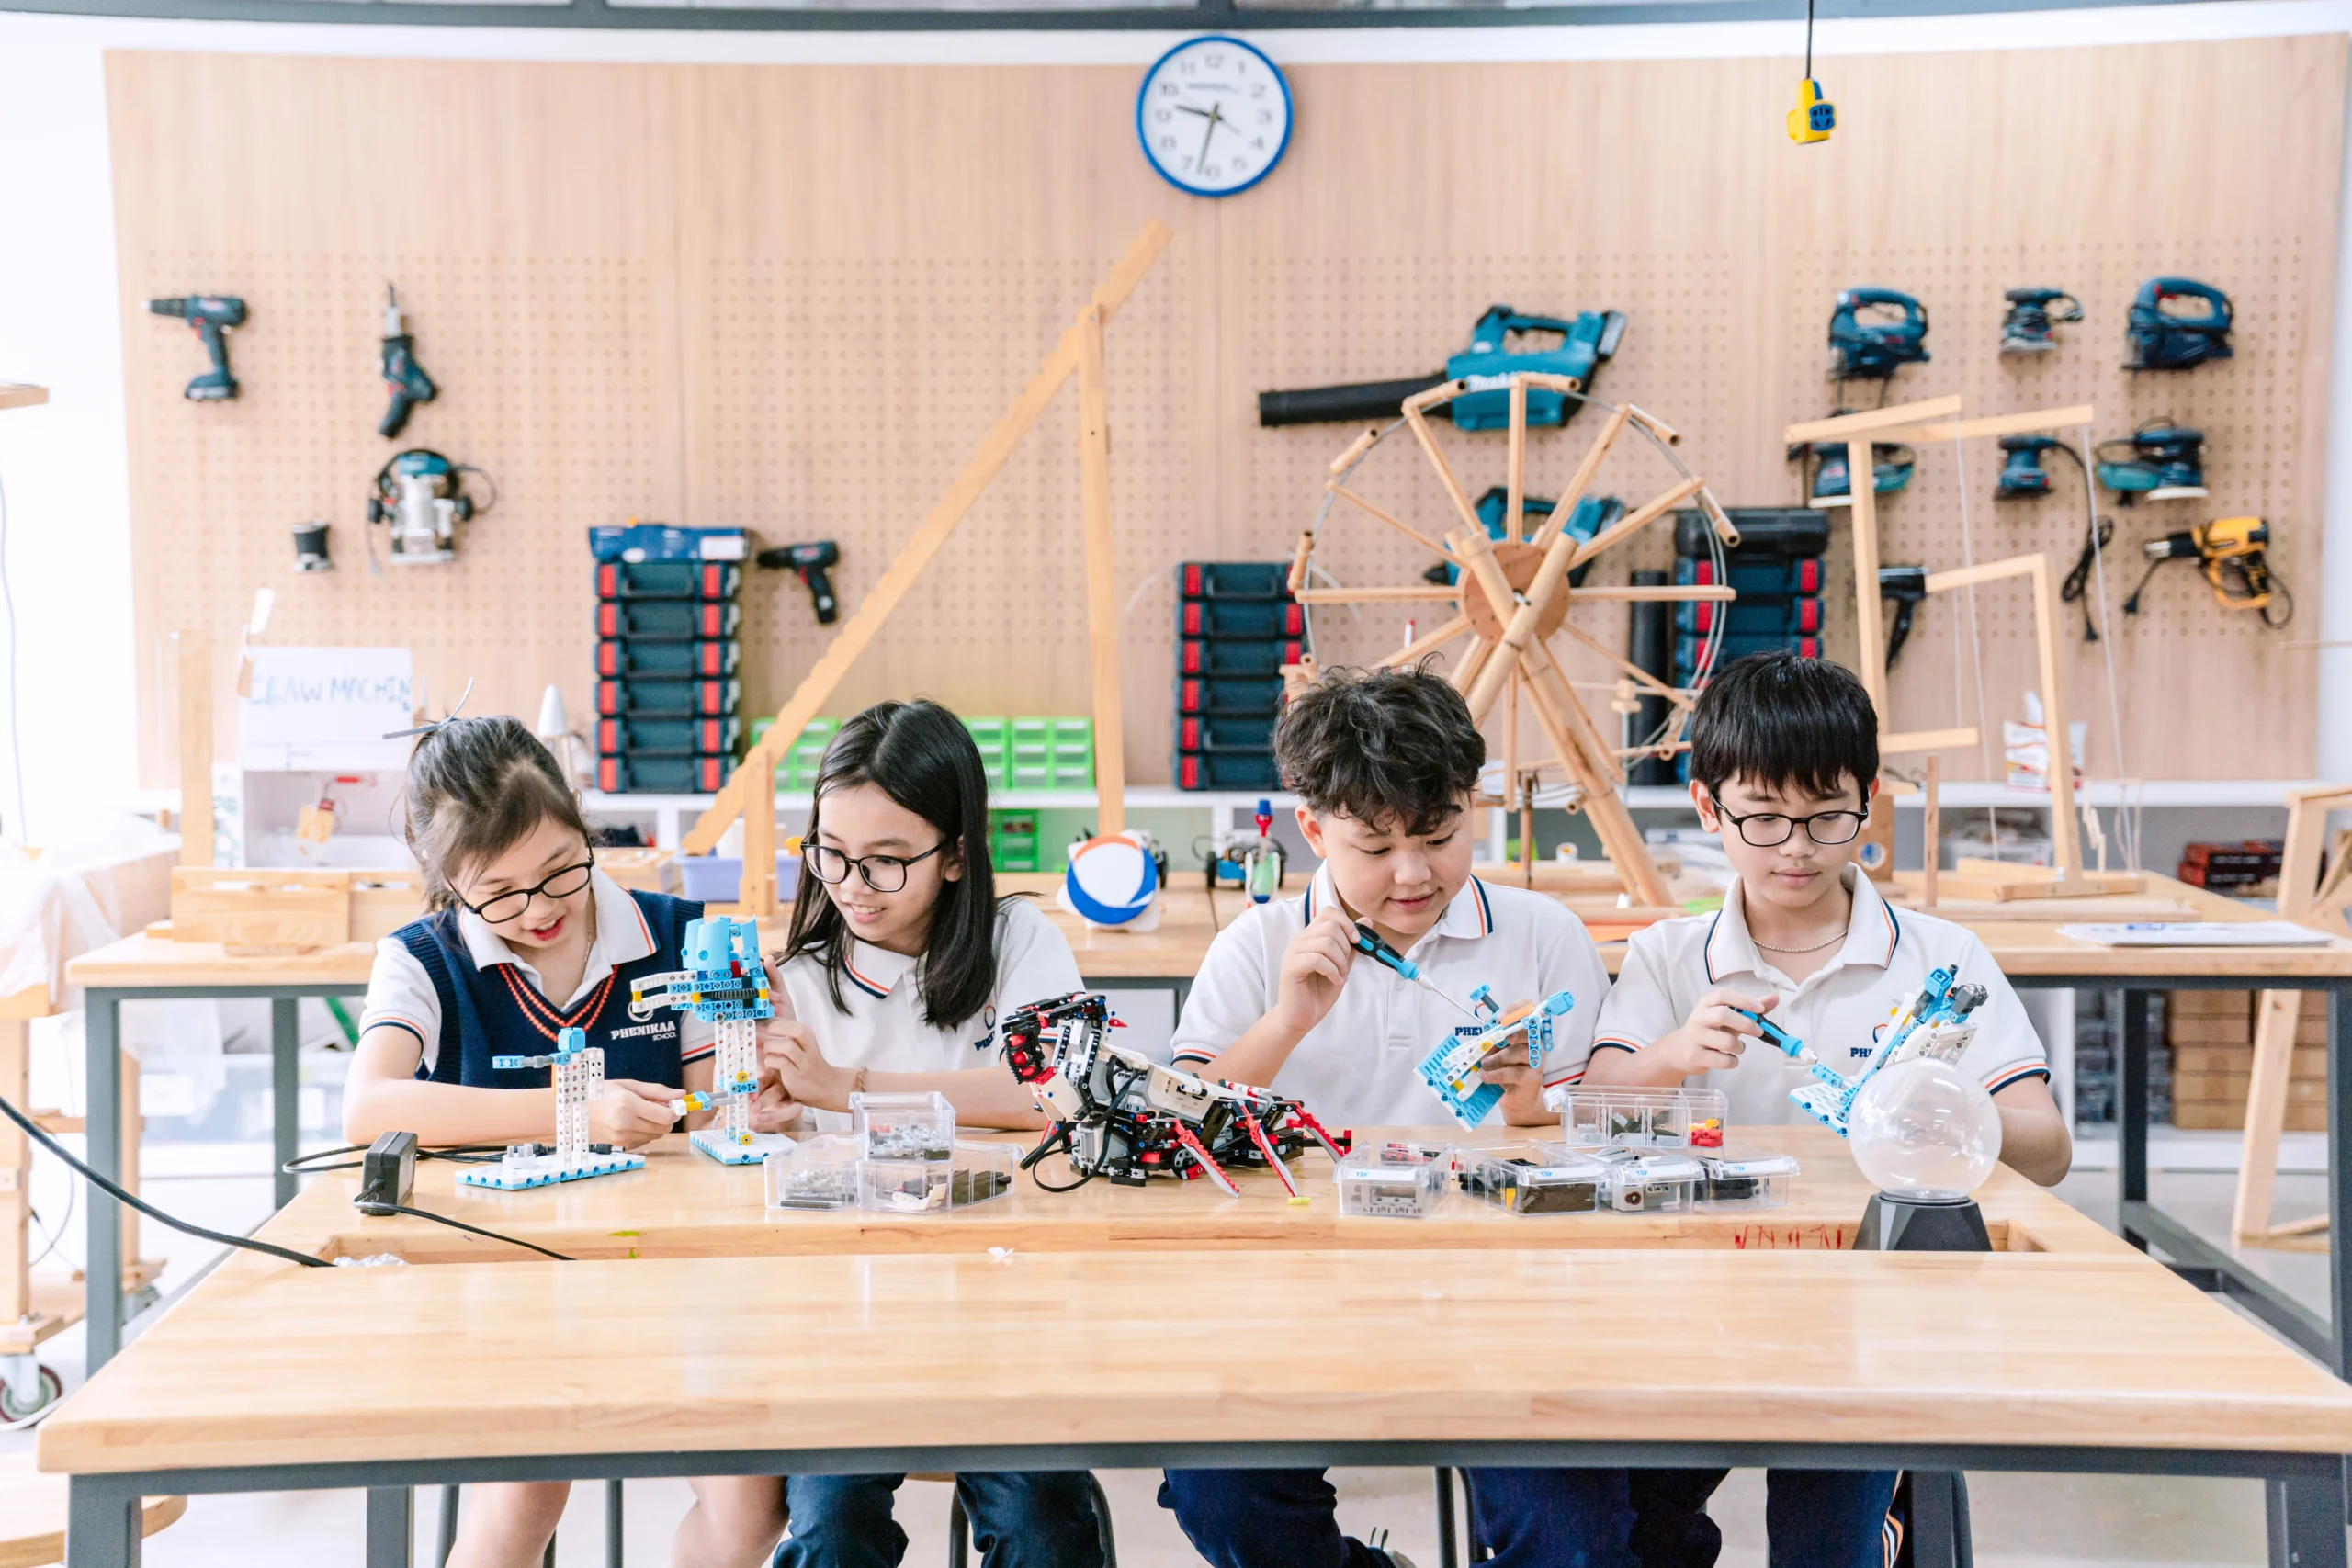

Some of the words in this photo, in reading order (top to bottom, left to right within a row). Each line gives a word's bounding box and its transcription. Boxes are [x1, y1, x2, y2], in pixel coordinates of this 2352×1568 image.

[1159, 82, 1180, 96] 10
[610, 1021, 676, 1040] PHENIKAA
[652, 1032, 678, 1041] SCHOOL
[1455, 1026, 1483, 1036] PHE
